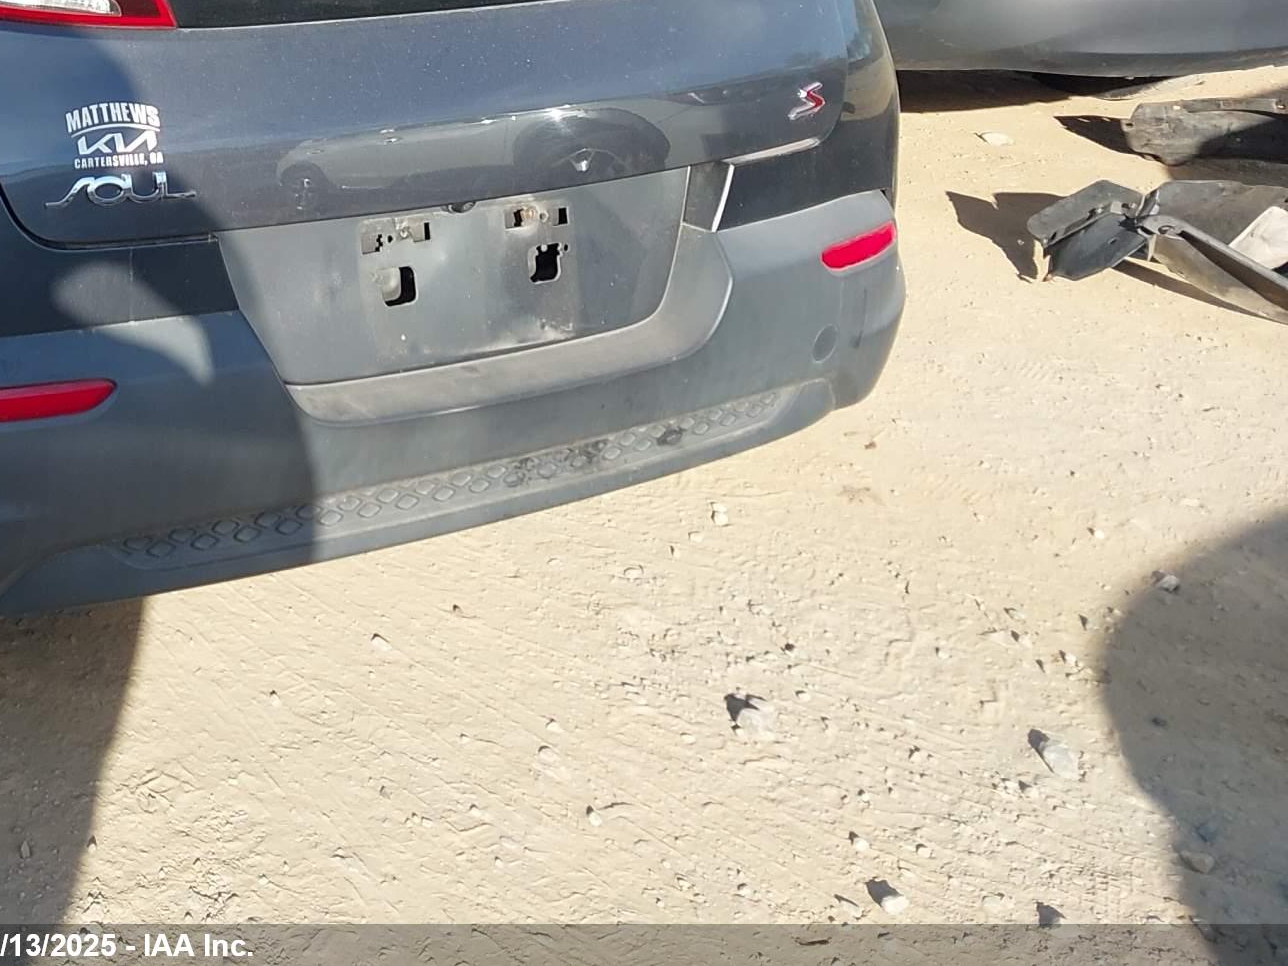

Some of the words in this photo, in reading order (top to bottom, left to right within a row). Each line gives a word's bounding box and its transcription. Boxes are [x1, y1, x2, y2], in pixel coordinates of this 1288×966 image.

[787, 81, 826, 121] S
[65, 102, 161, 133] MATTHEWS
[77, 130, 158, 155] KIA
